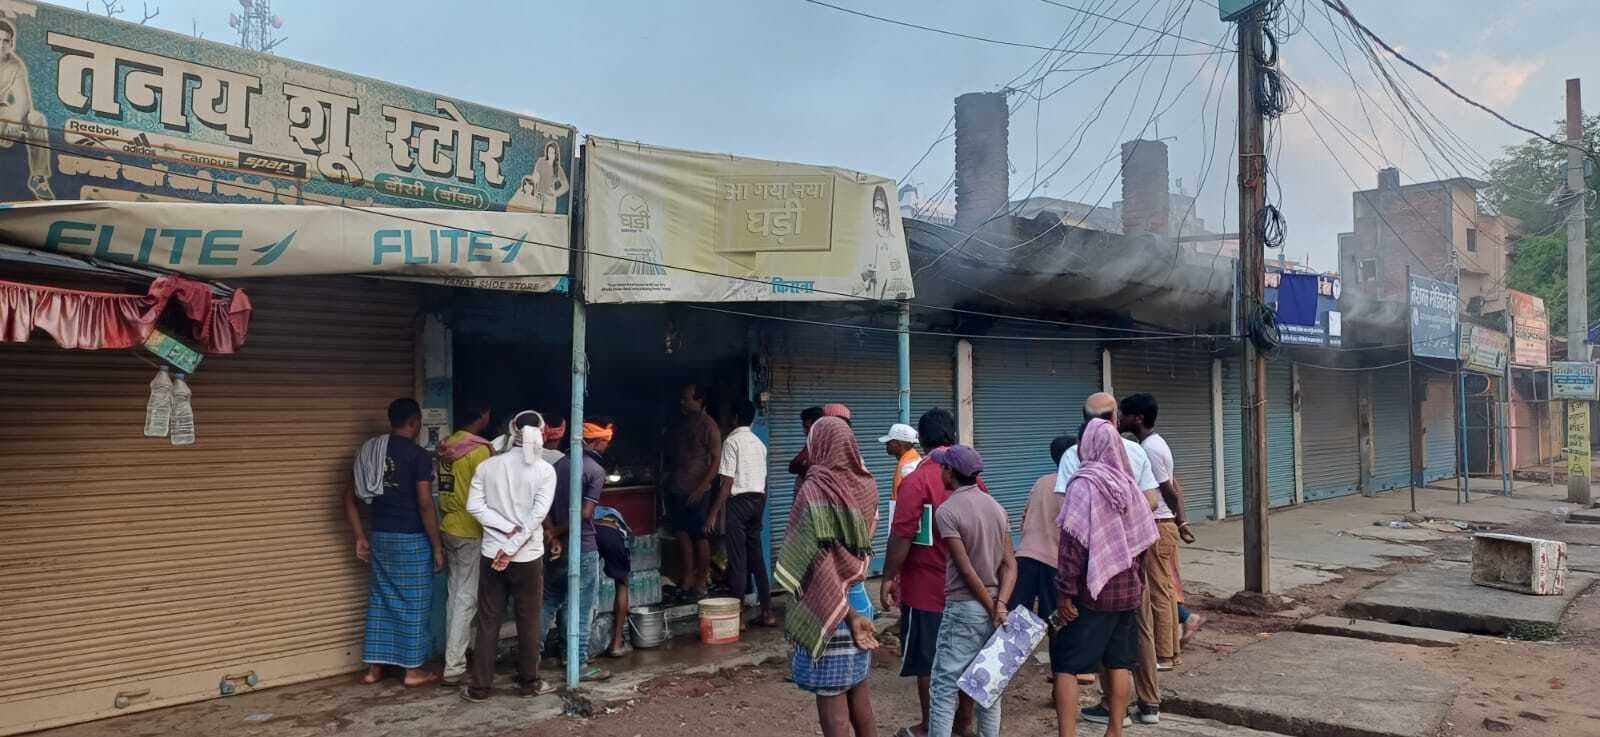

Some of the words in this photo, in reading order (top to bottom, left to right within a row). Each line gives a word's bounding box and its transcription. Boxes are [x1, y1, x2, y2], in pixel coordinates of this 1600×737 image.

[48, 32, 262, 144] तनय
[282, 82, 364, 186] शू
[382, 98, 512, 190] स्टोर
[70, 121, 121, 138] Reebok
[122, 144, 157, 157] adidas
[181, 152, 235, 169] campus
[242, 154, 304, 174] sparx
[723, 183, 749, 200] आ
[751, 183, 788, 200] गया
[790, 183, 827, 200] नया
[745, 199, 807, 245] घड़ी
[372, 229, 493, 265] FLITE
[479, 279, 506, 289] SHOE
[508, 281, 541, 291] STORE
